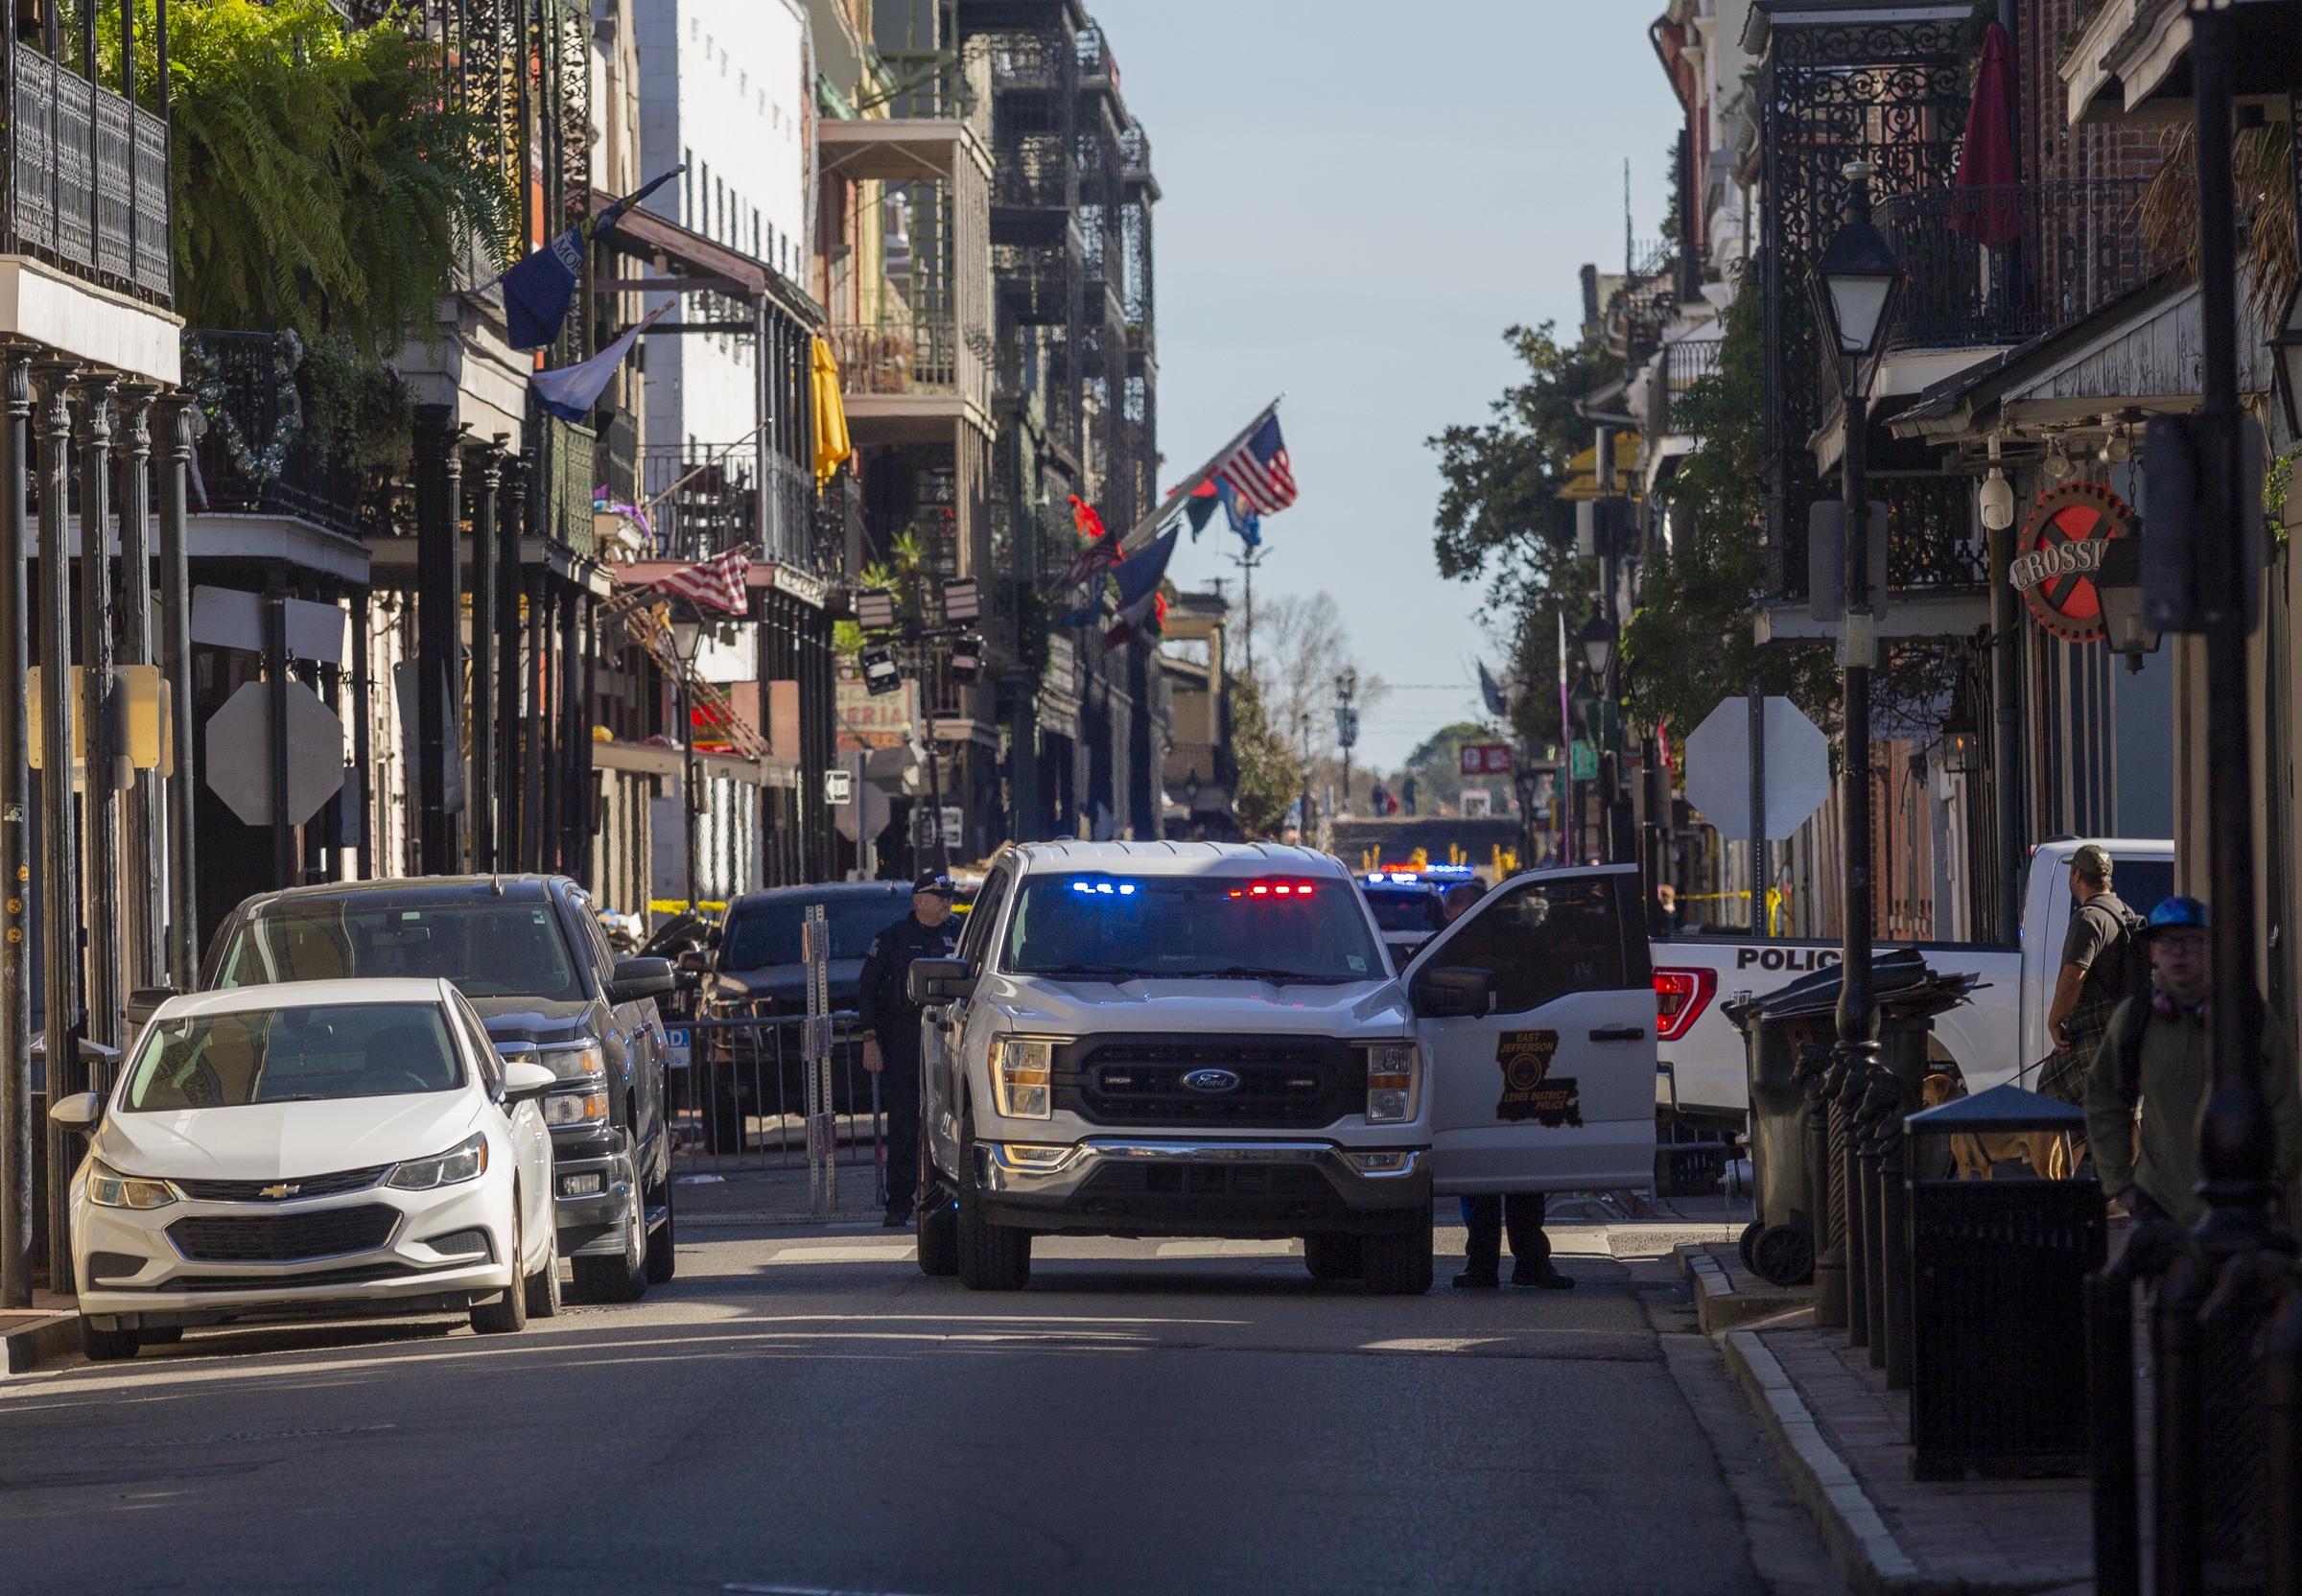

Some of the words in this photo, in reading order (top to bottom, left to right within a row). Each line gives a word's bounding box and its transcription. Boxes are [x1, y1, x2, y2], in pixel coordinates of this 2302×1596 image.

[2009, 538, 2108, 590] CROSSI
[837, 706, 903, 726] ERIA
[1737, 948, 1842, 972] POLIC
[1515, 1032, 1541, 1043] EAST
[1500, 1043, 1555, 1053] JEFFERSON
[1196, 1074, 1228, 1087] Ford
[1504, 1091, 1530, 1102] LEVEE
[1532, 1090, 1567, 1101] DISTRICT
[1535, 1100, 1565, 1111] POLICE
